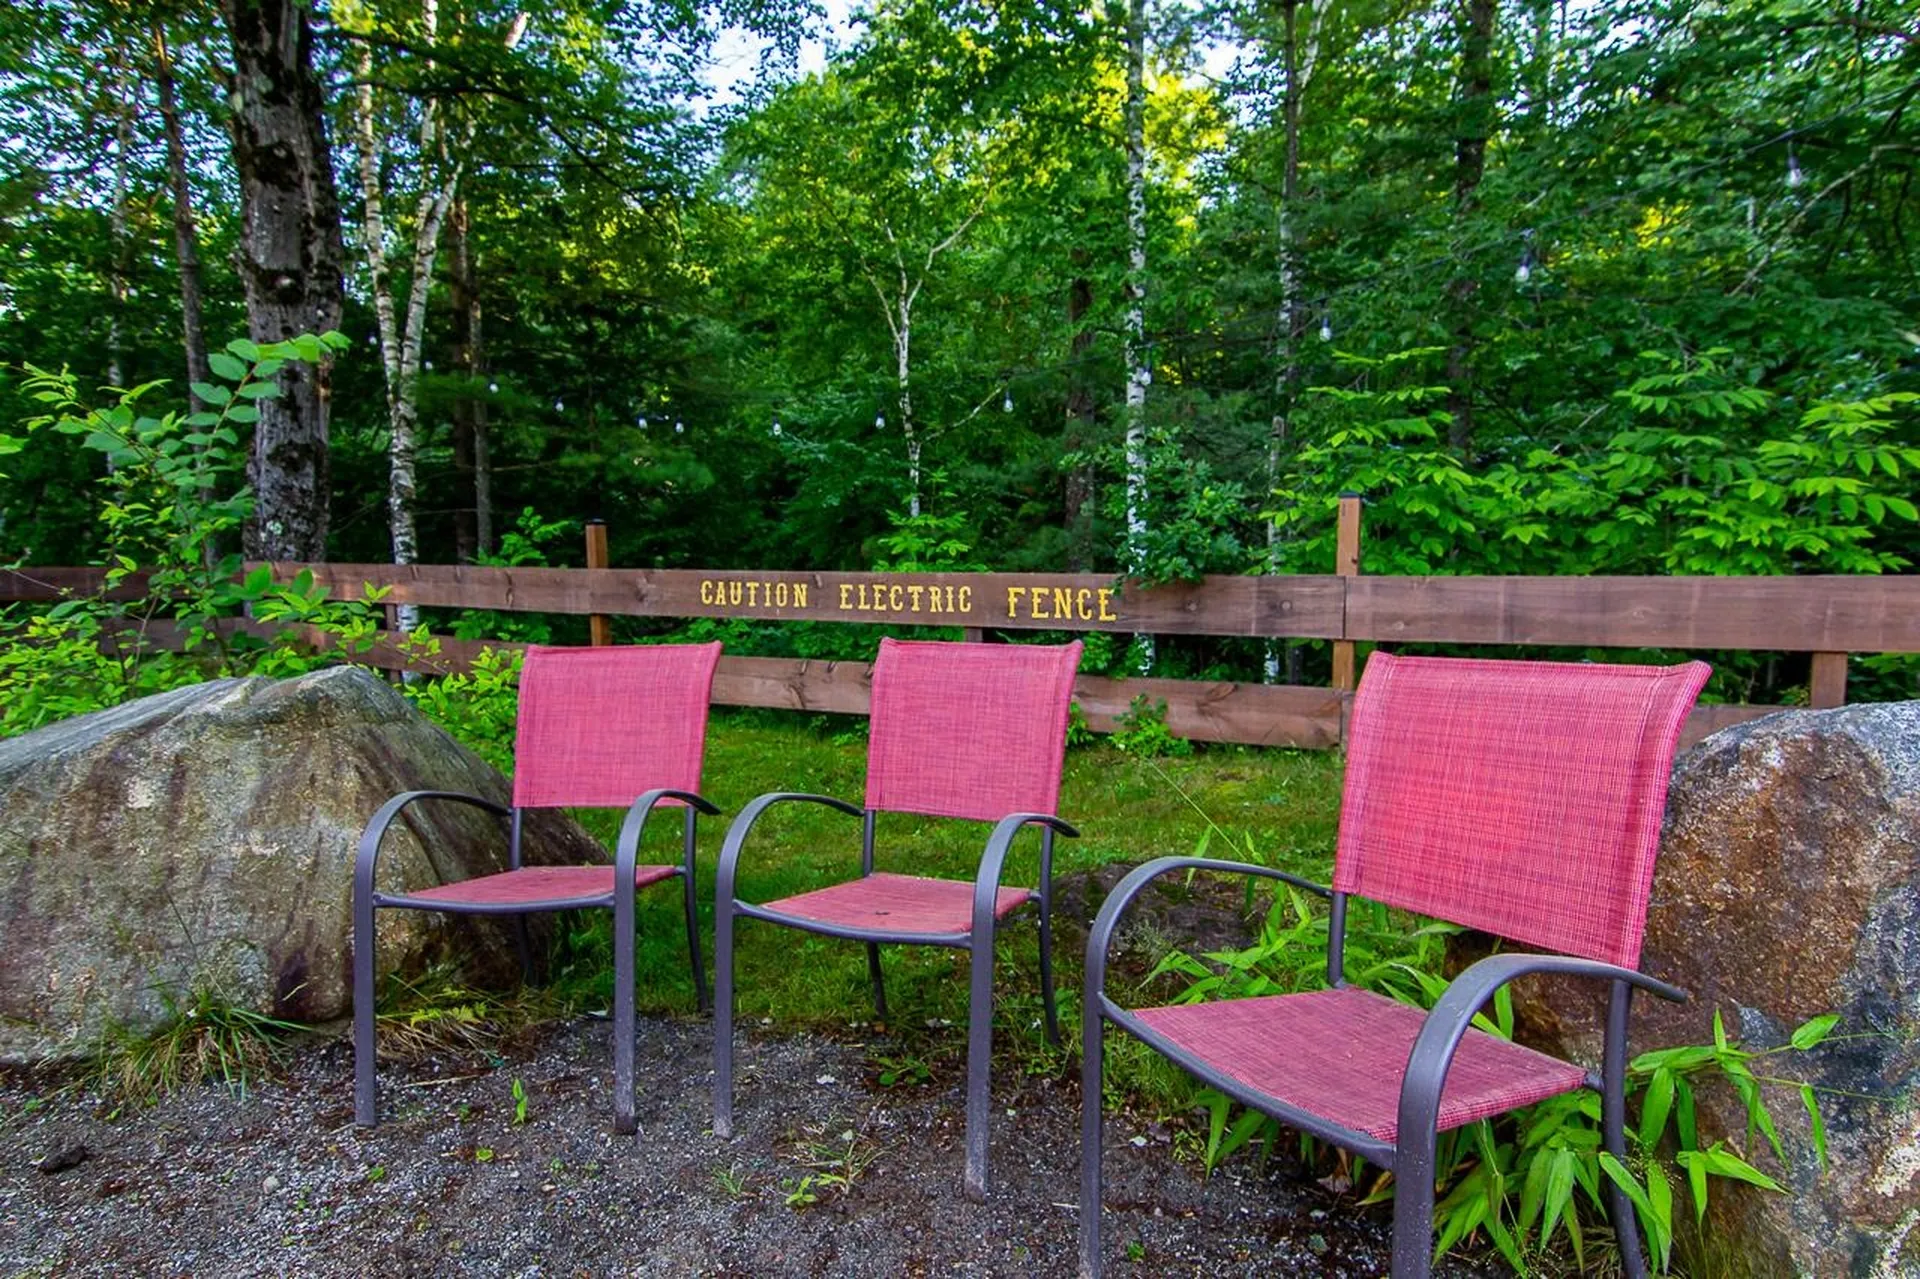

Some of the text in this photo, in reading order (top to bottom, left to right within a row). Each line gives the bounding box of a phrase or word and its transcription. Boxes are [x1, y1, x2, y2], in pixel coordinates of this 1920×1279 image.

[699, 579, 1117, 622] CAUTION ELECTRIC FENCE
